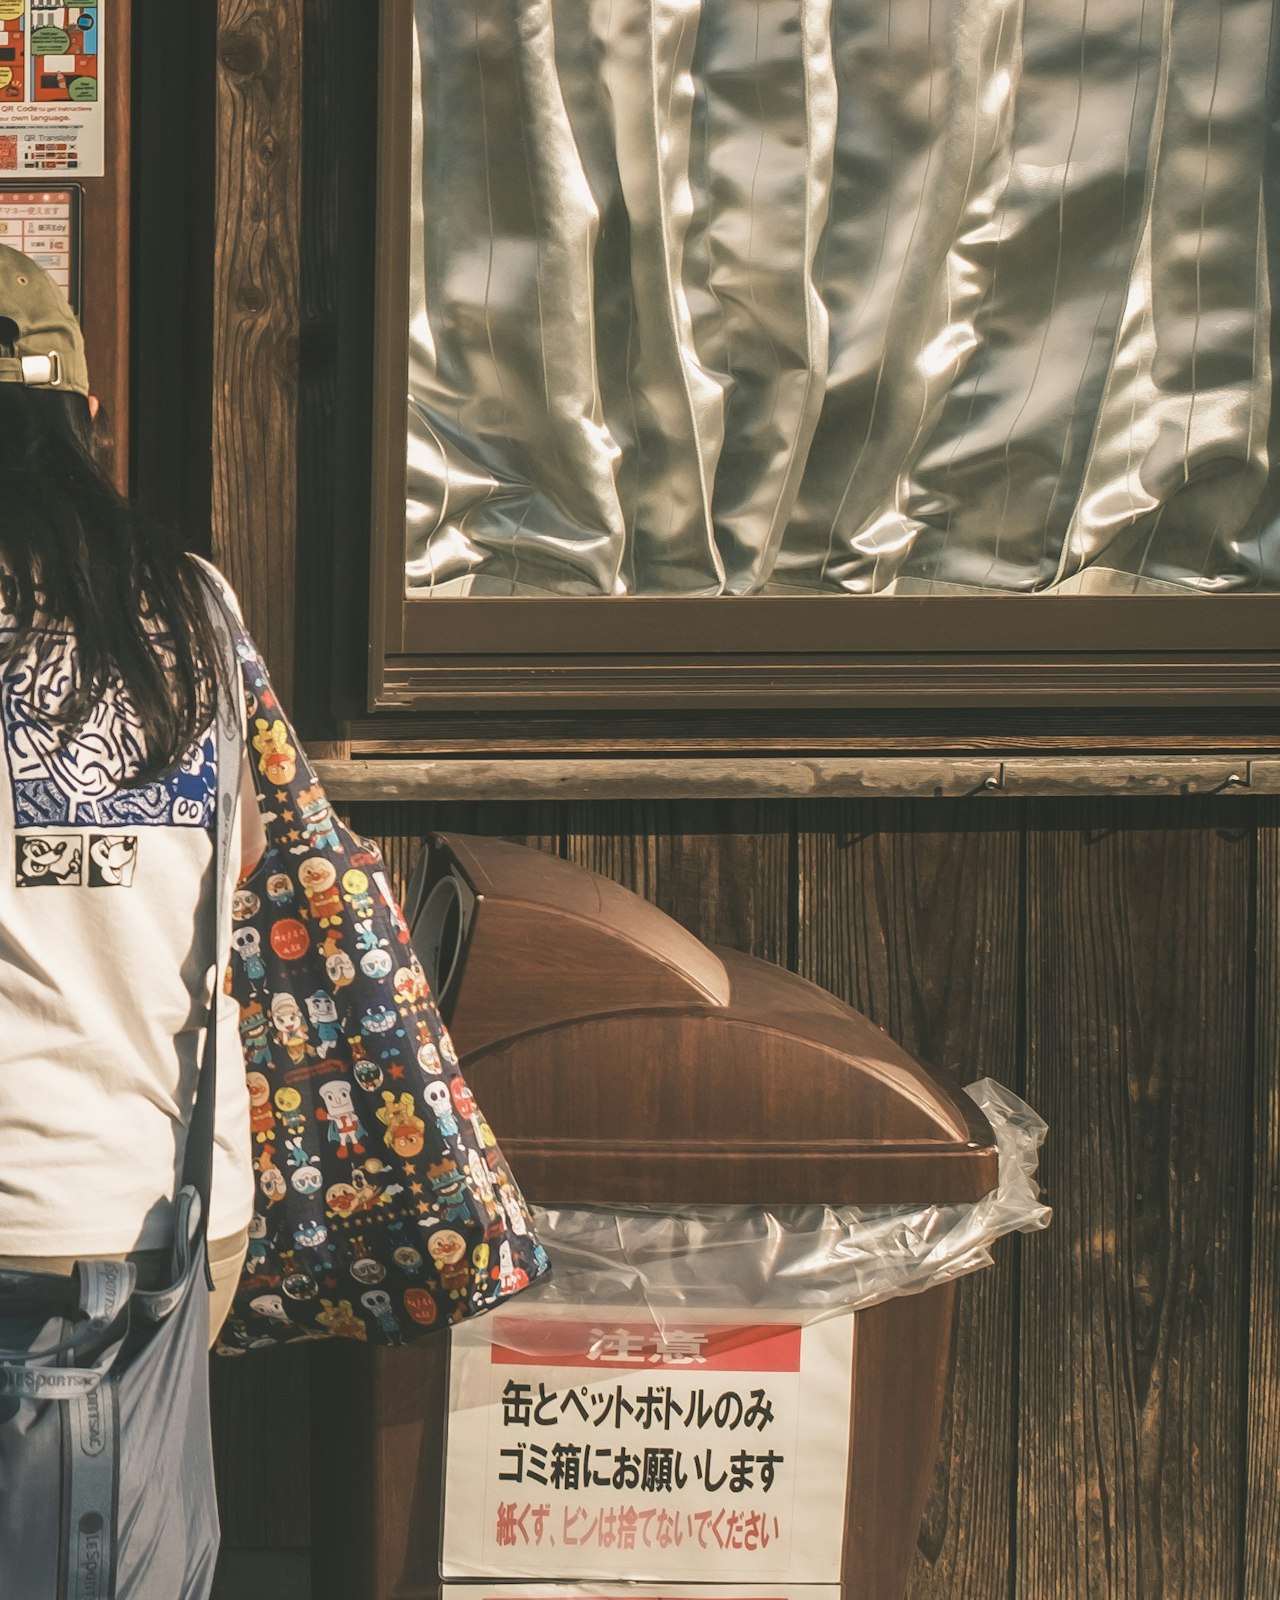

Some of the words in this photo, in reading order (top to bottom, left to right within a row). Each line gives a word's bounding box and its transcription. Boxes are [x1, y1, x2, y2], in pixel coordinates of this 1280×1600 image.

[585, 1327, 708, 1364] 注意
[501, 1379, 775, 1431] 缶とペットボトルのみ
[498, 1443, 784, 1493] ゴミ箱にお願いします
[496, 1501, 779, 1551] 紙くず、ビンは捨てないでください
